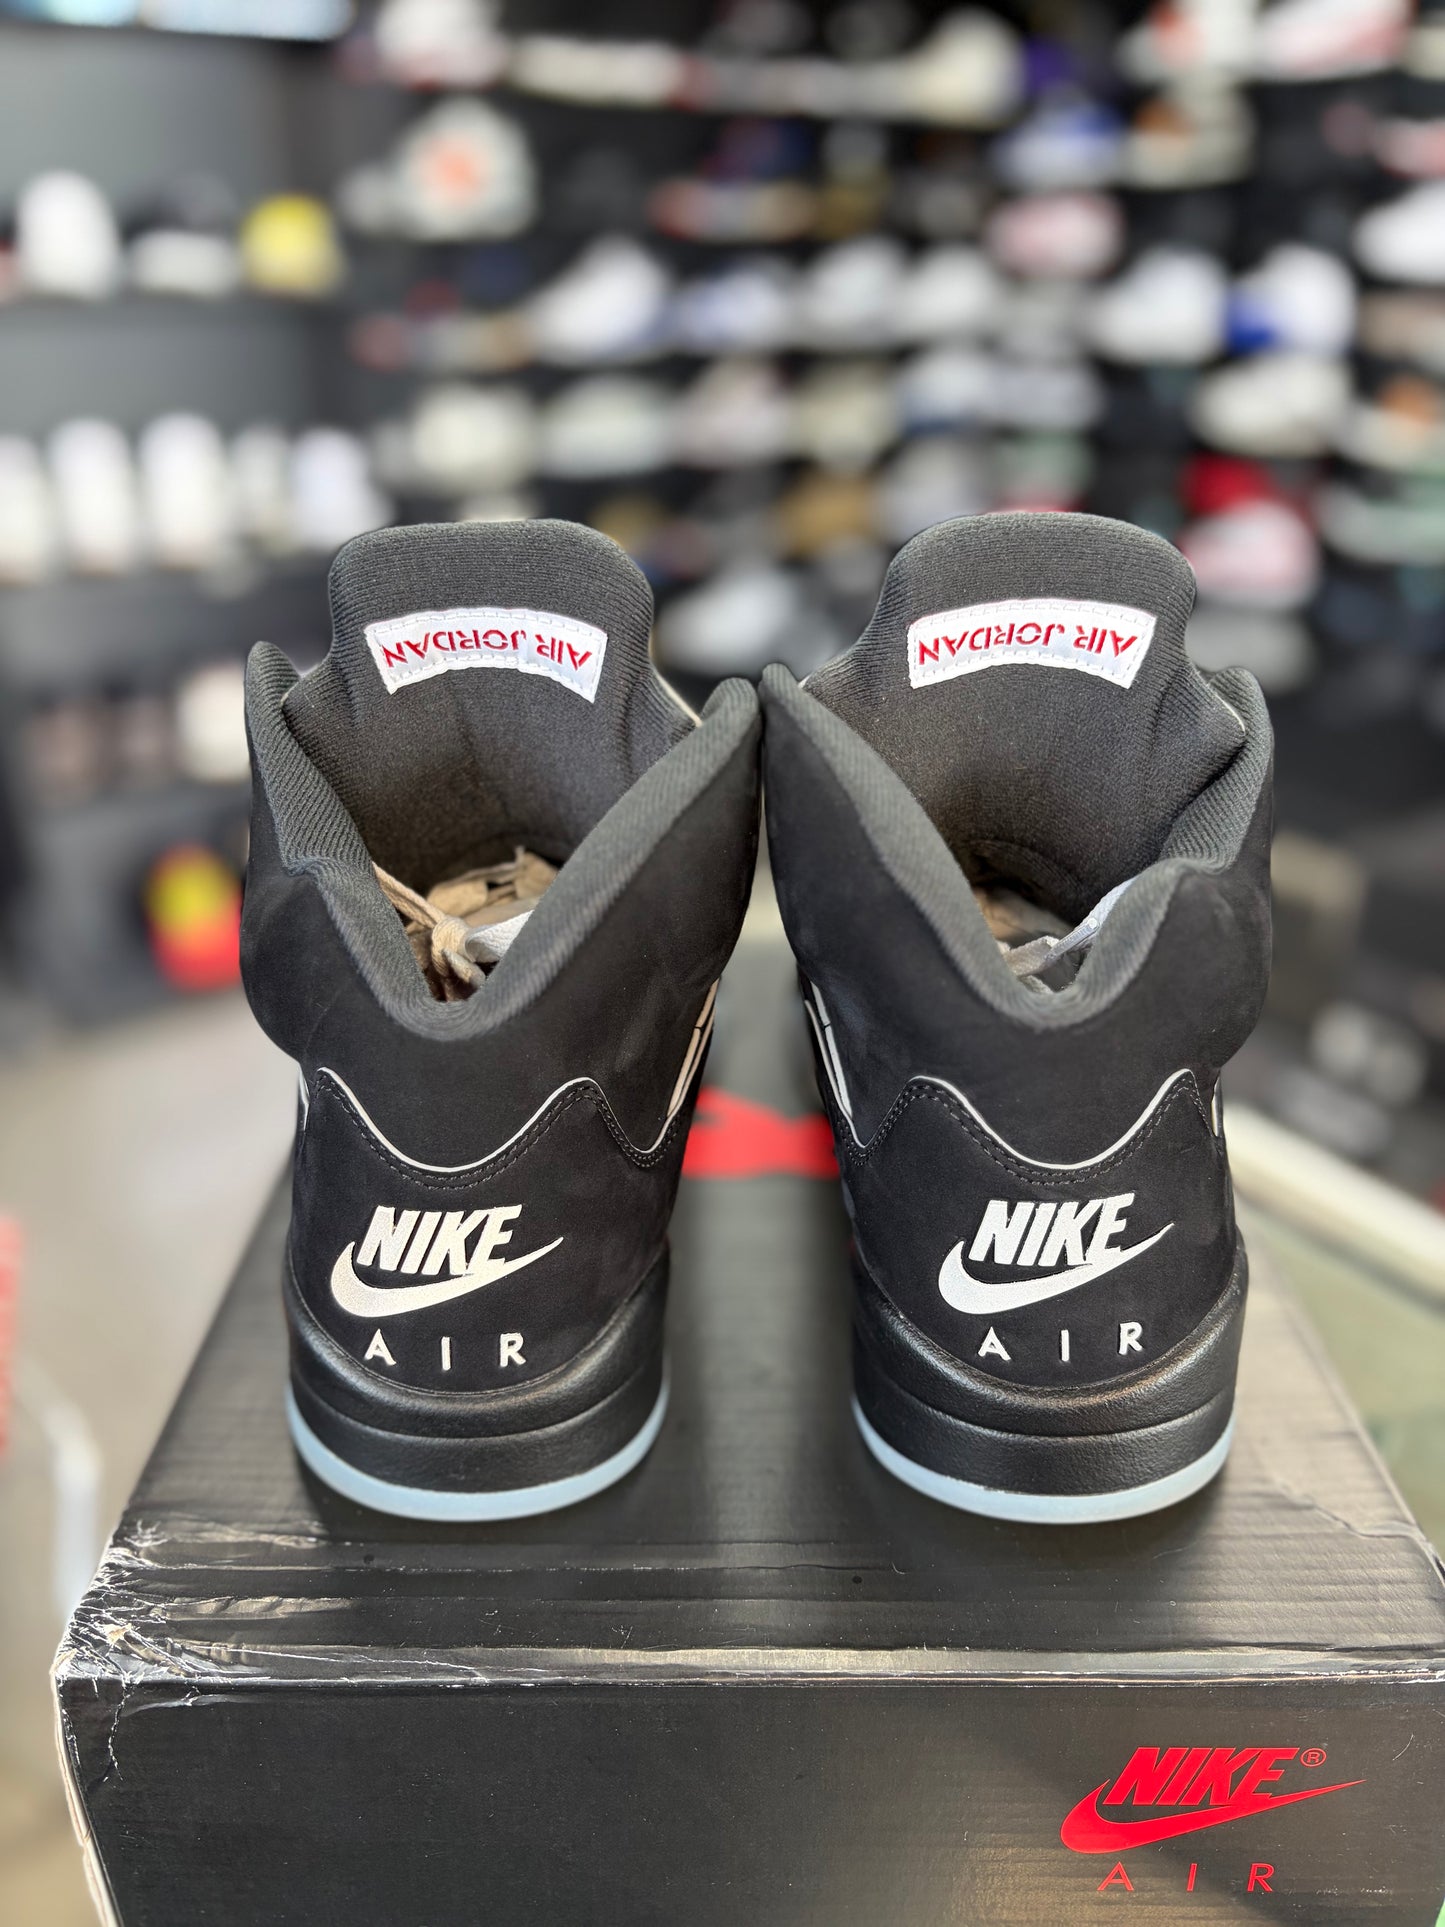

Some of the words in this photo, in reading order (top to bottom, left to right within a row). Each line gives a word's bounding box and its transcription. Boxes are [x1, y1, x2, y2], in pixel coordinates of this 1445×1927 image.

[381, 629, 527, 668] JORDAN
[535, 633, 593, 671] AIR
[918, 622, 1066, 666] JORDAN
[1073, 624, 1138, 658] AIR
[356, 1204, 523, 1276] NIKE
[967, 1192, 1136, 1267] NIKE
[363, 1328, 527, 1372] AIR
[977, 1321, 1144, 1363] AIR
[1096, 1860, 1275, 1892] AIR
